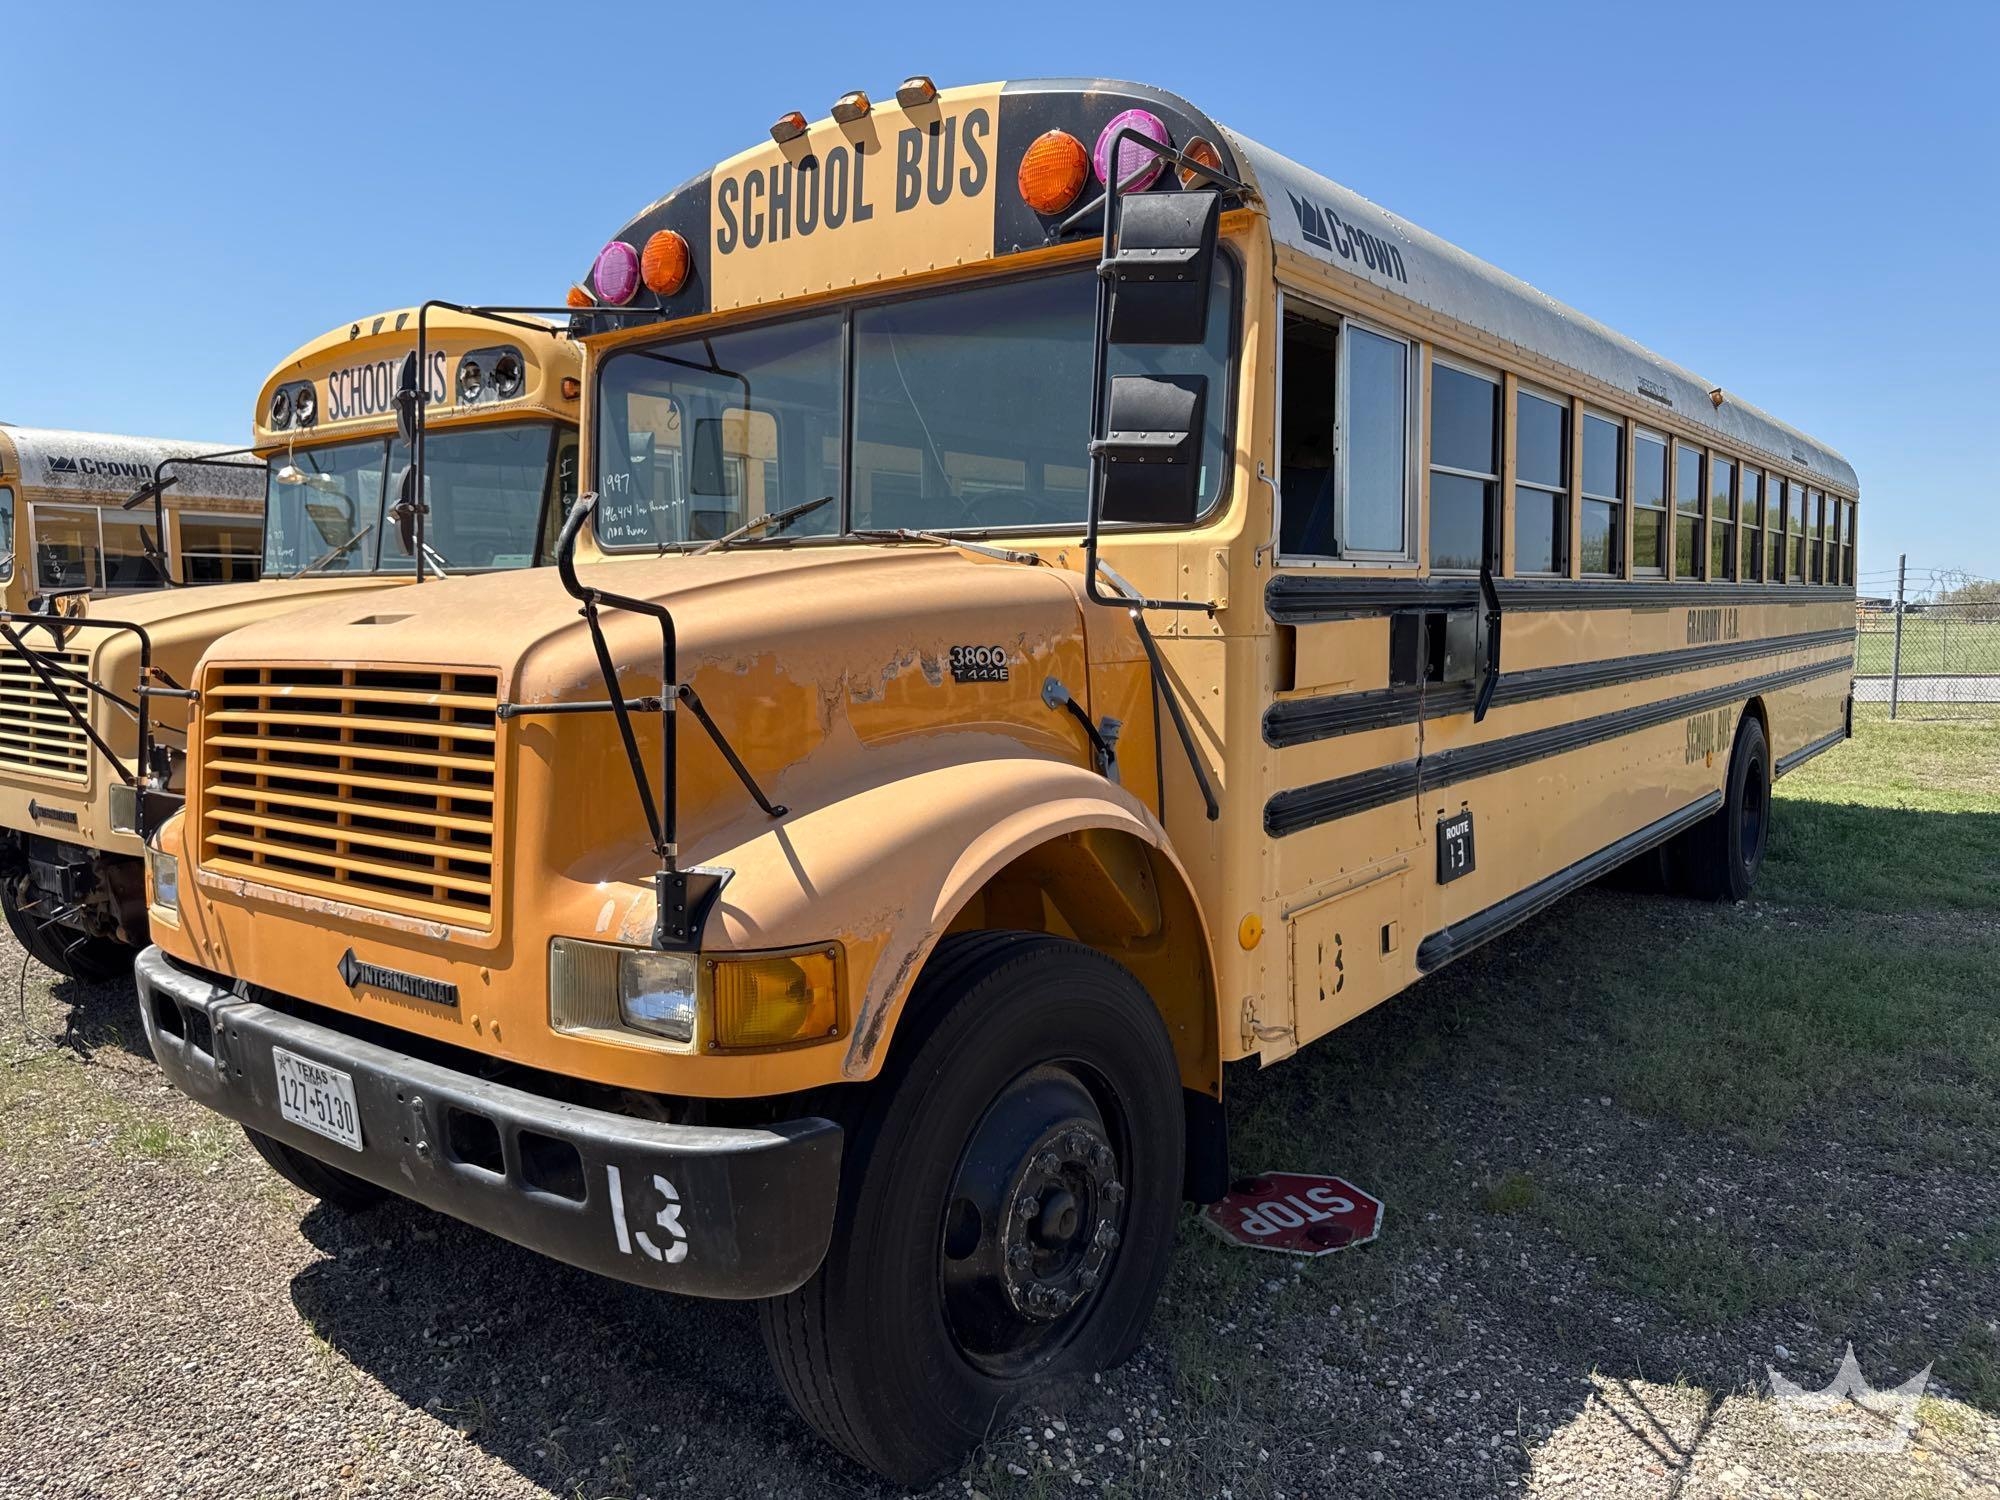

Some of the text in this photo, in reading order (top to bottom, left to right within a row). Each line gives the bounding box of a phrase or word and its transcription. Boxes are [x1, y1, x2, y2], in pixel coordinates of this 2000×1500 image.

[716, 108, 990, 255] SCHOOL BUS
[1324, 207, 1407, 284] Crown
[328, 361, 397, 420] SCHOOL
[79, 457, 152, 478] Crown
[602, 473, 630, 497] 1997
[950, 646, 1007, 668] 3800
[1685, 707, 1731, 765] SCHOOL BUS
[1446, 820, 1469, 840] ROUTE
[1450, 838, 1464, 869] 13
[361, 963, 456, 1004] INTERNATIONAL
[296, 1060, 328, 1085] TEXAS
[606, 1164, 689, 1264] 13
[1239, 1187, 1356, 1236] STOP
